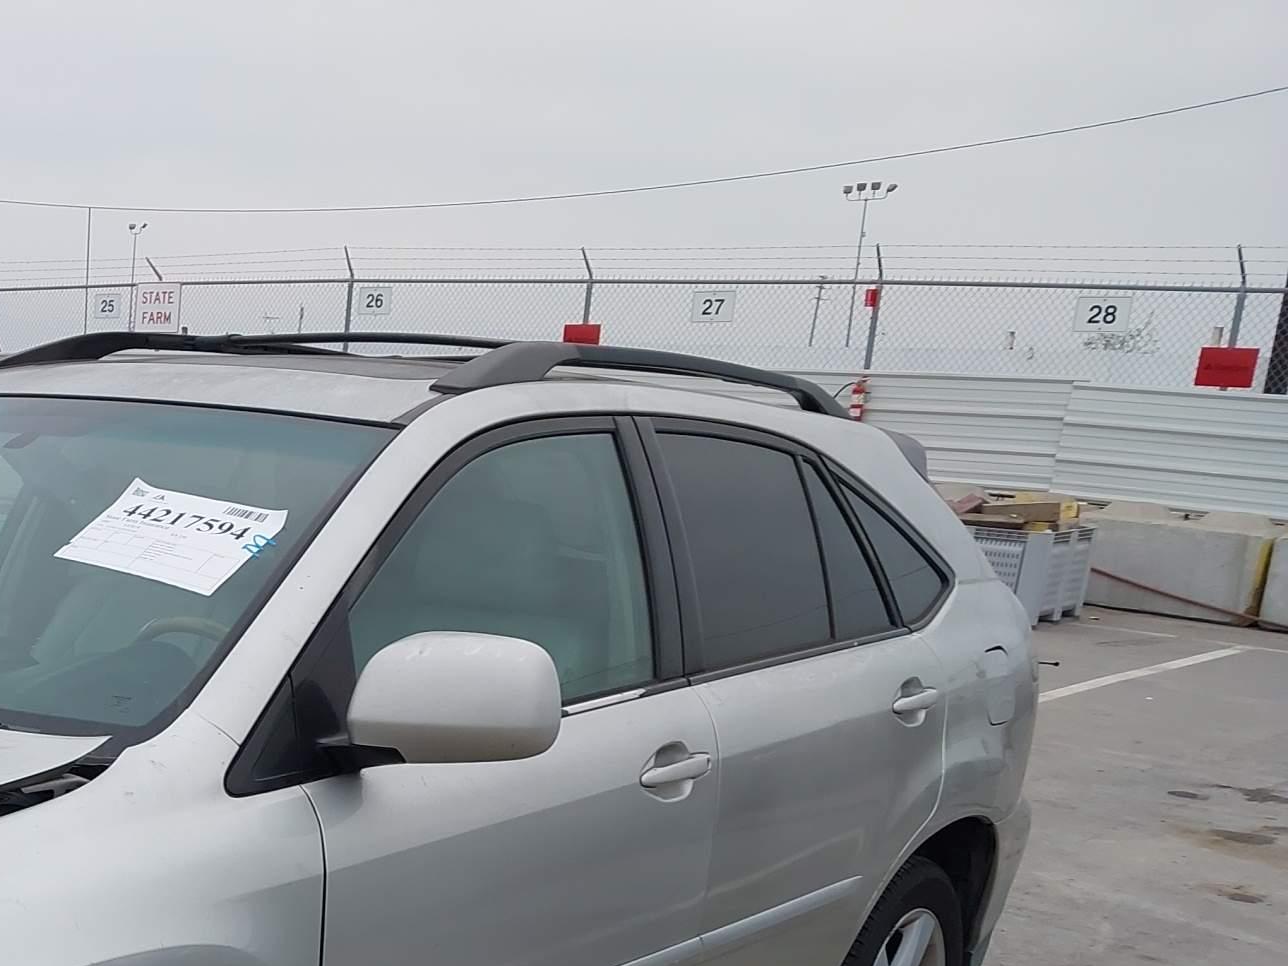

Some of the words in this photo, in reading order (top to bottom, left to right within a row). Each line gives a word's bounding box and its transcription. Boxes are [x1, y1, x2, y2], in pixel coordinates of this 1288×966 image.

[141, 290, 175, 305] STATE
[365, 293, 384, 309] 26
[100, 299, 115, 313] 25
[701, 298, 725, 316] 27
[141, 311, 172, 325] FARM
[1087, 304, 1118, 325] 28
[123, 503, 252, 541] 44217594
